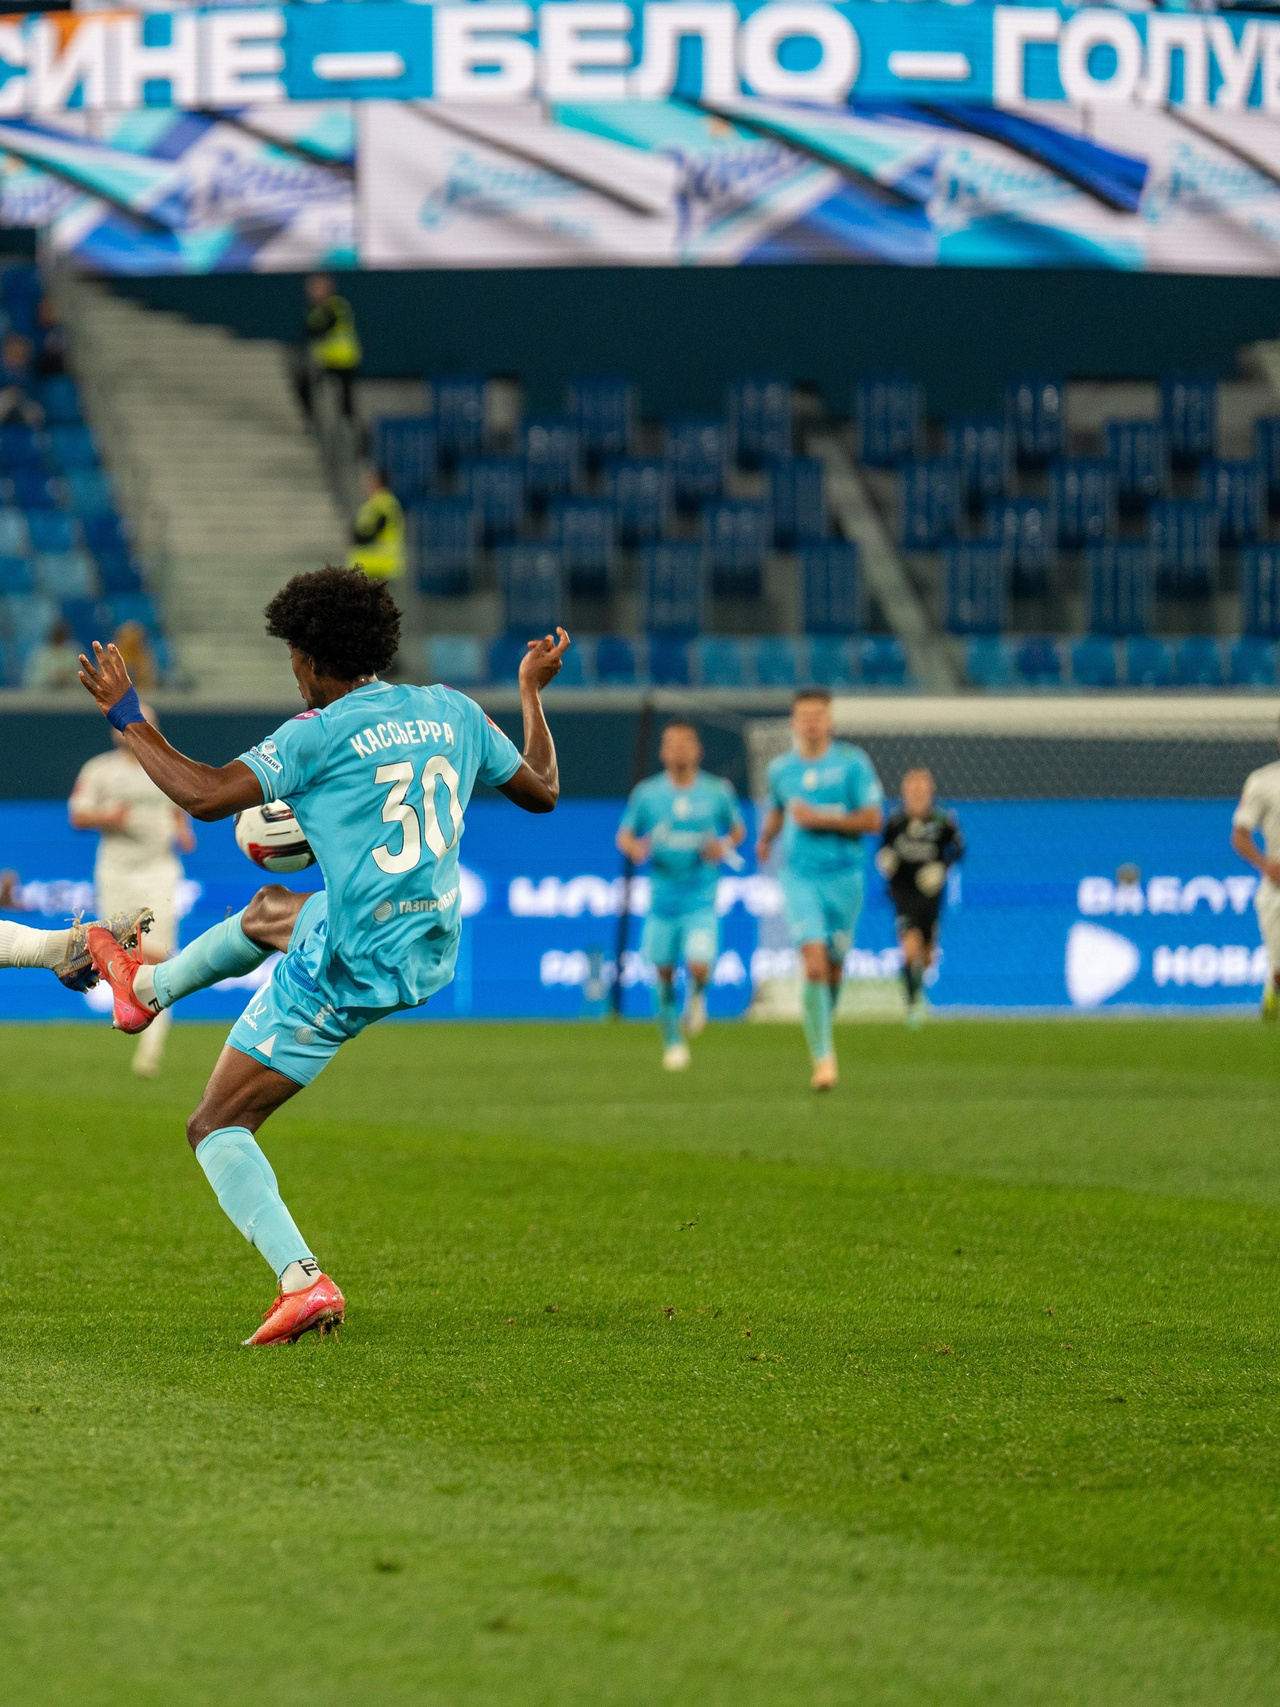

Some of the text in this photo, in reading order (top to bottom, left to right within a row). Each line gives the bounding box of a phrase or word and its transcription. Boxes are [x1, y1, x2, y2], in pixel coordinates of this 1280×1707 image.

[433, 2, 862, 102] БЕЛО
[350, 720, 455, 759] КАССЬЕРРА
[371, 754, 464, 875] 30
